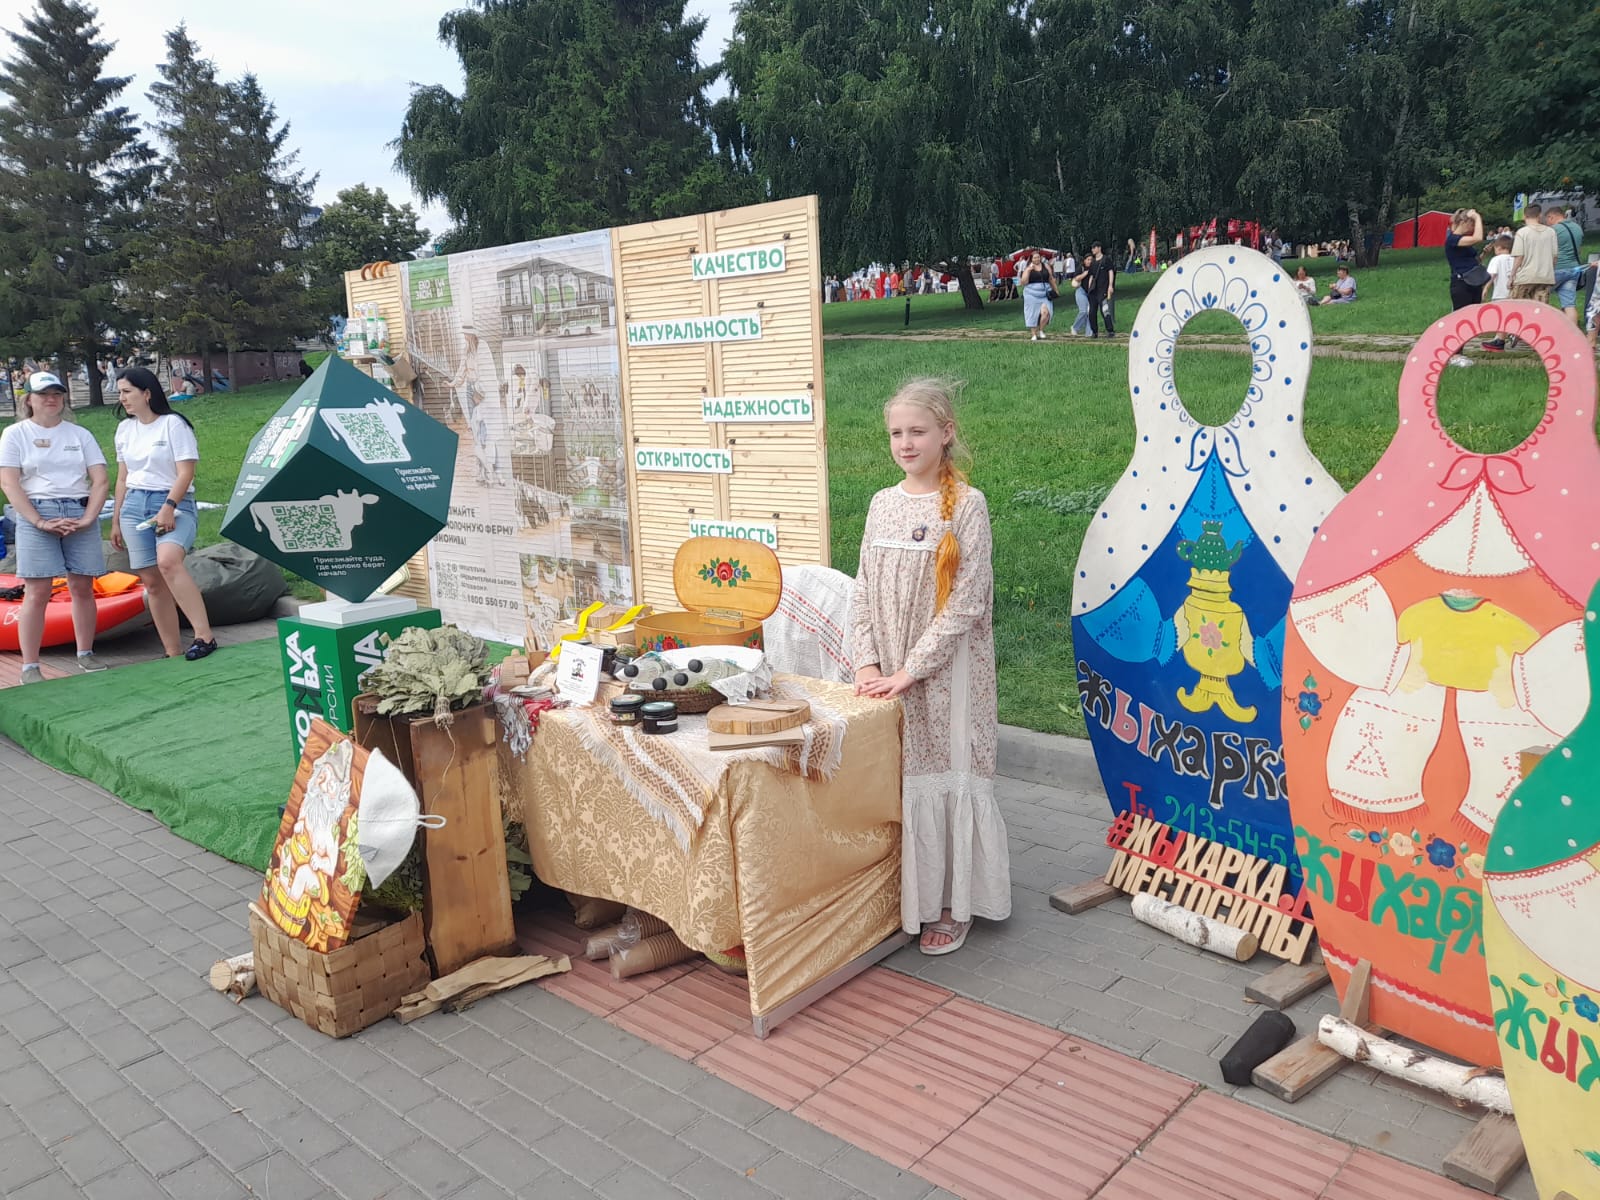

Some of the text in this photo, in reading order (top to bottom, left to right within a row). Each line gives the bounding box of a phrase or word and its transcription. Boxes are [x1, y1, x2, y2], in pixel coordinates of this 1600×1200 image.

[692, 248, 783, 276] КАЧЕСТВО
[628, 318, 759, 342] НАТУРАЛЬНОСТЬ
[703, 399, 811, 418] НАДЕЖНОСТЬ
[636, 451, 730, 469] ОТКРЫТОСТЬ
[485, 525, 514, 536] ФЕРМУ
[690, 524, 775, 544] ЧЕСТНОСТЬ
[313, 555, 363, 564] Приезжайте
